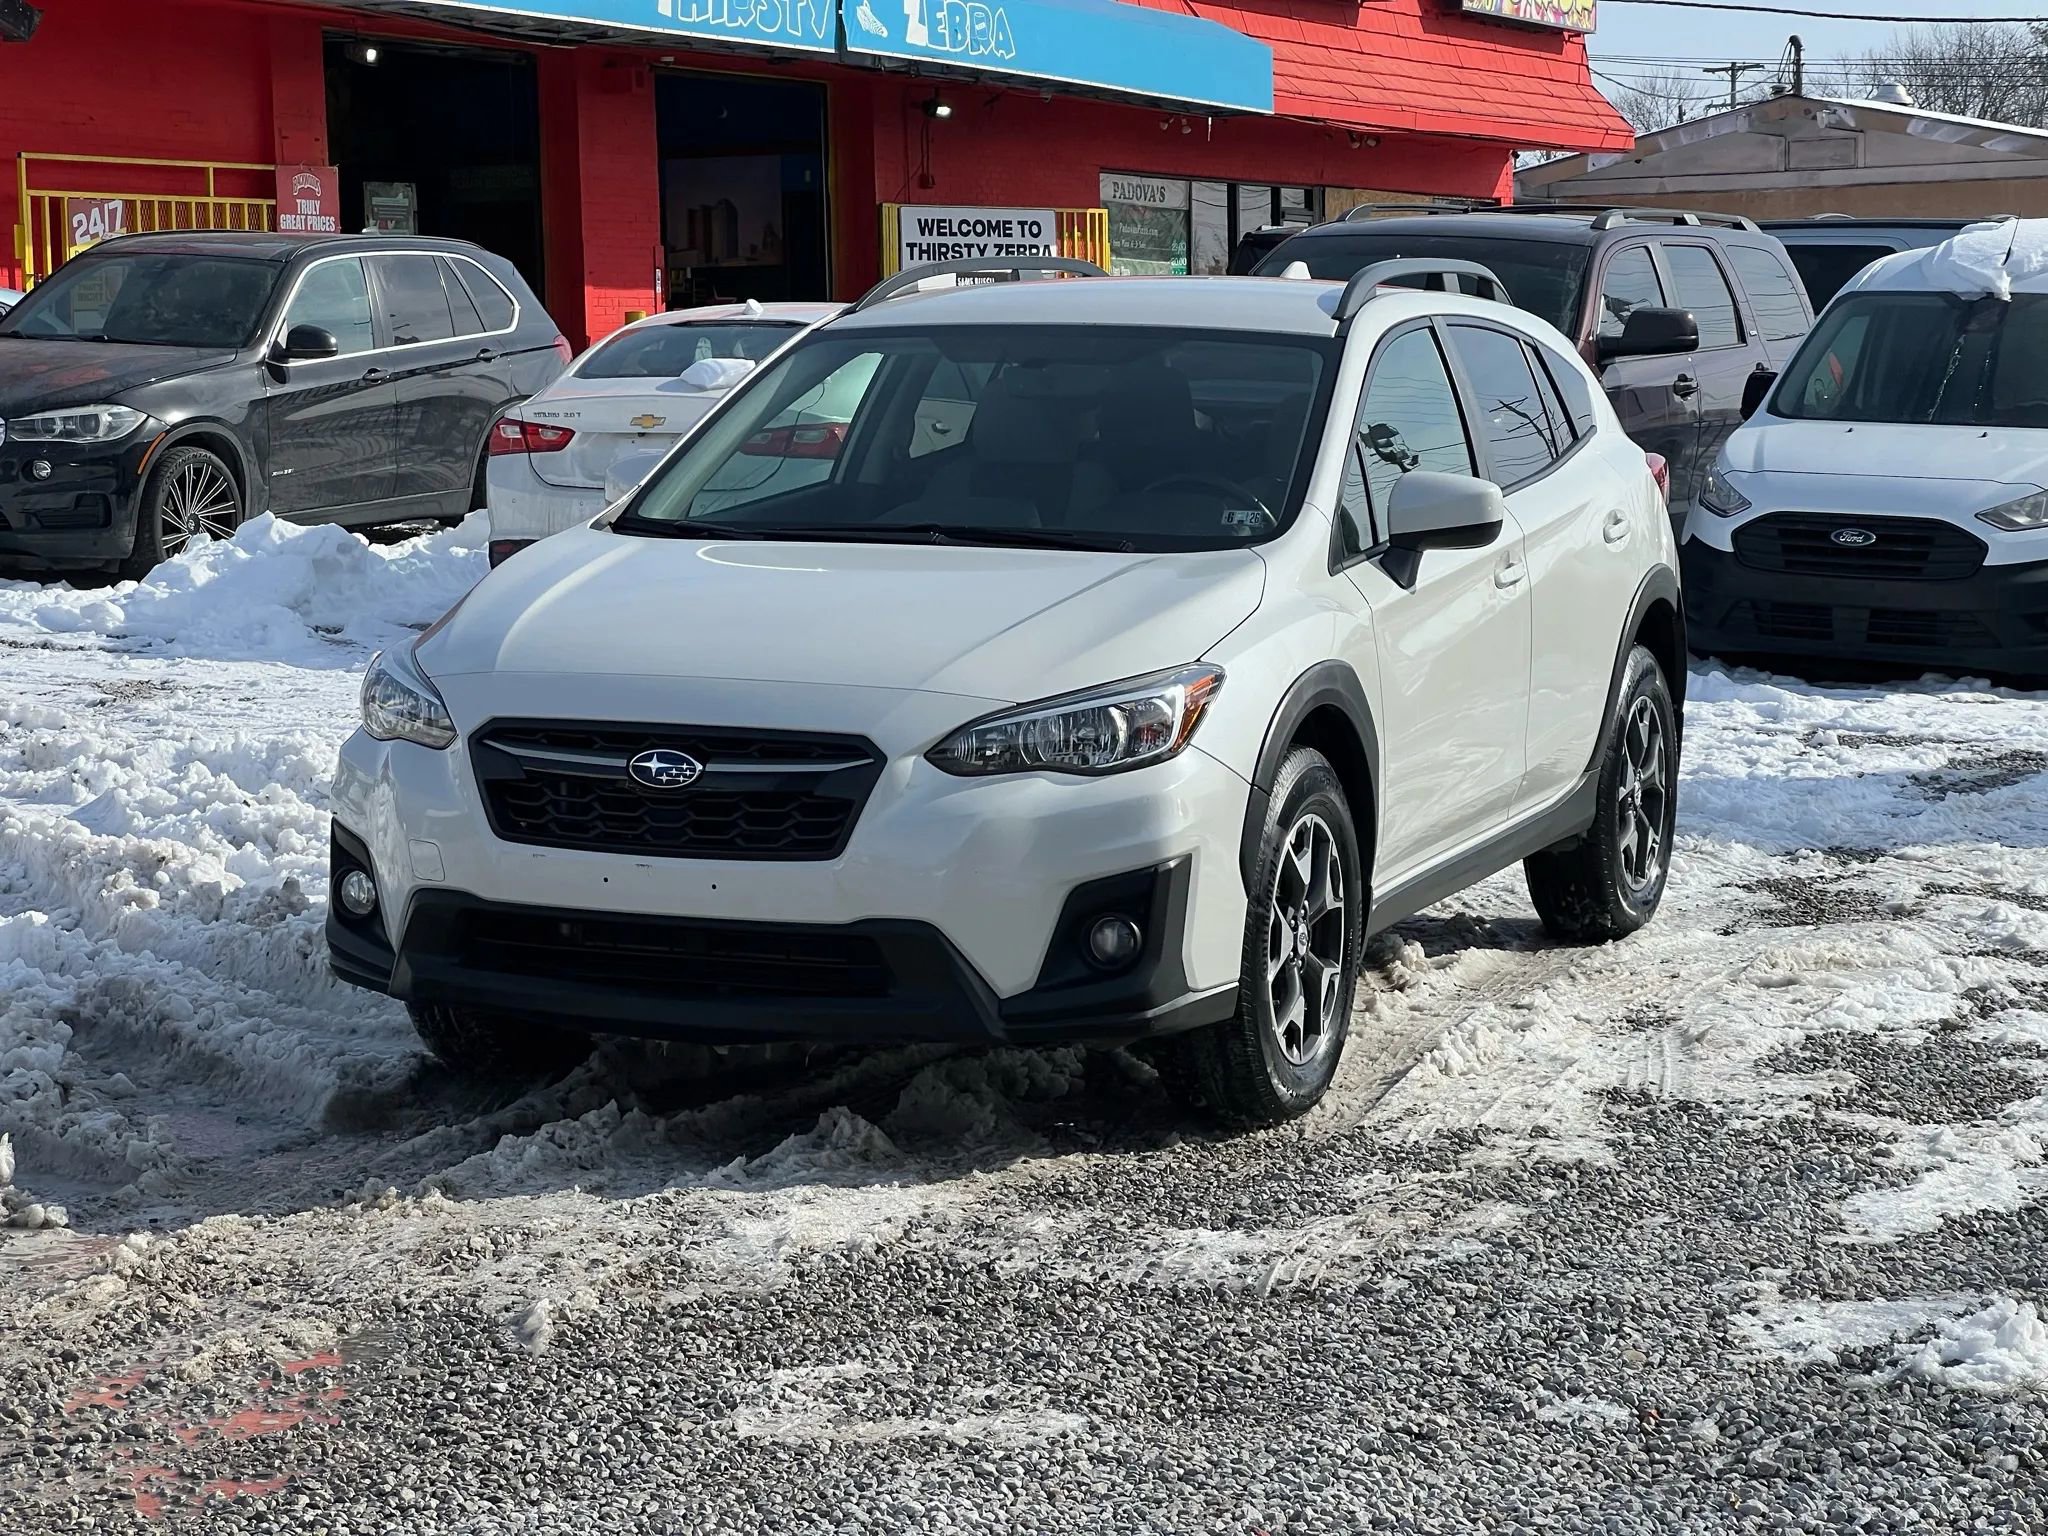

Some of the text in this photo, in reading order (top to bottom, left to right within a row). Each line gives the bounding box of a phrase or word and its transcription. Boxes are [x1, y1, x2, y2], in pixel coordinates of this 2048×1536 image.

[903, 0, 1016, 59] ZEBRA
[1112, 181, 1166, 203] PADOVA'S
[296, 199, 320, 214] TRULY
[72, 199, 123, 245] 24/7
[280, 214, 335, 231] GREAT PRICES
[917, 218, 1042, 238] WELCOME TO
[906, 242, 989, 261] THIRSTY
[1839, 530, 1865, 543] Ford
